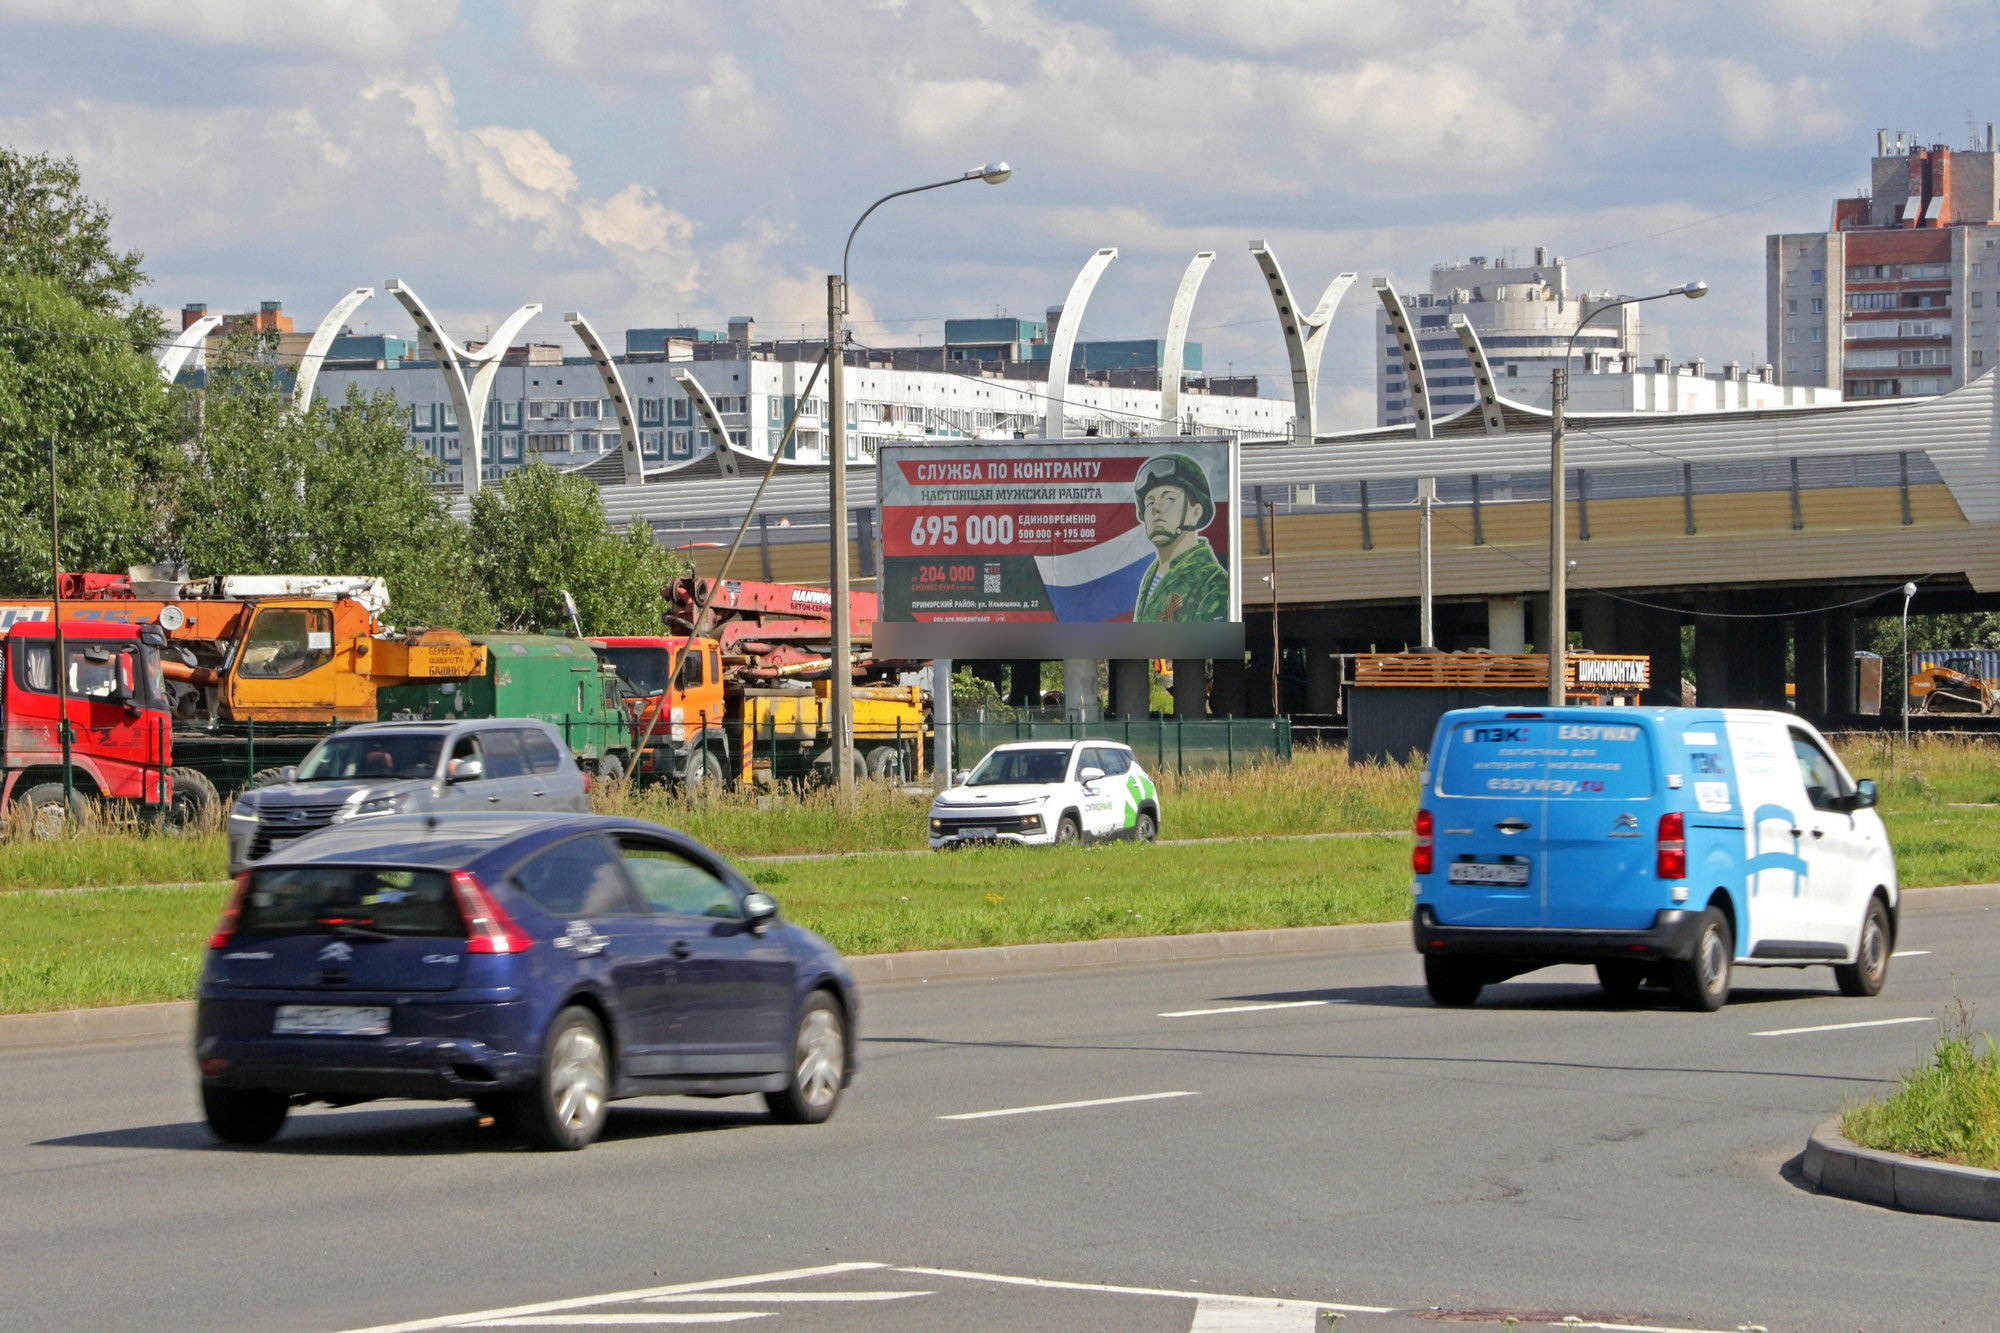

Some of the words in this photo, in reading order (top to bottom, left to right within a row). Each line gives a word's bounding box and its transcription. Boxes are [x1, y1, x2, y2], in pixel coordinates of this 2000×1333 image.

[917, 463, 982, 480] СЛУЖБА
[988, 463, 1008, 479] ПО
[1013, 461, 1101, 479] КОНТРАКТУ
[921, 489, 994, 502] НАСТОЯЩАЯ
[996, 488, 1056, 501] МУЖСКАЯ
[1058, 488, 1102, 500] РАБОТА
[1018, 514, 1096, 525] ЕДИНОВРЕМЕННО
[910, 515, 958, 546] 695
[966, 514, 1014, 545] 000
[1018, 529, 1035, 539] 500
[1036, 529, 1051, 539] 000
[1063, 528, 1078, 538] 195
[1080, 528, 1095, 538] 000
[920, 566, 946, 582] 204
[949, 565, 975, 582] 000
[912, 600, 953, 609] ПРИМОРСКИЙ
[954, 599, 977, 608] РАЙОН:
[1579, 661, 1645, 682] ШИНОМОНТАЖ
[1557, 725, 1640, 741] EASYWAY
[1487, 777, 1605, 795] easyway.ru
